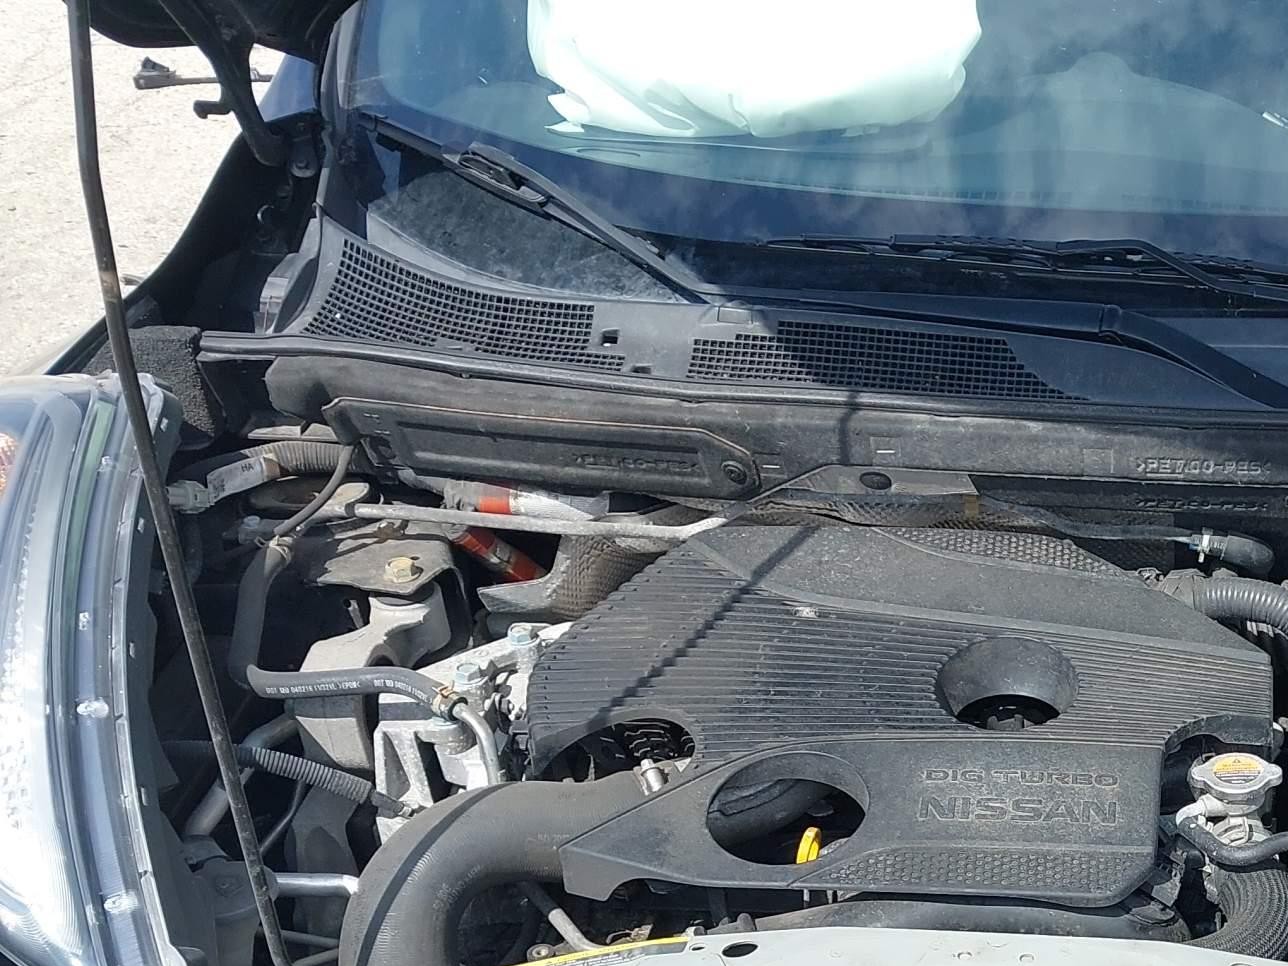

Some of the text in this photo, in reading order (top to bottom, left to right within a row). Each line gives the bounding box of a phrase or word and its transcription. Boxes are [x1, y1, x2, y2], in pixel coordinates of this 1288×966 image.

[923, 768, 1120, 788] DIG TURBO
[917, 797, 1119, 826] NISSAN
